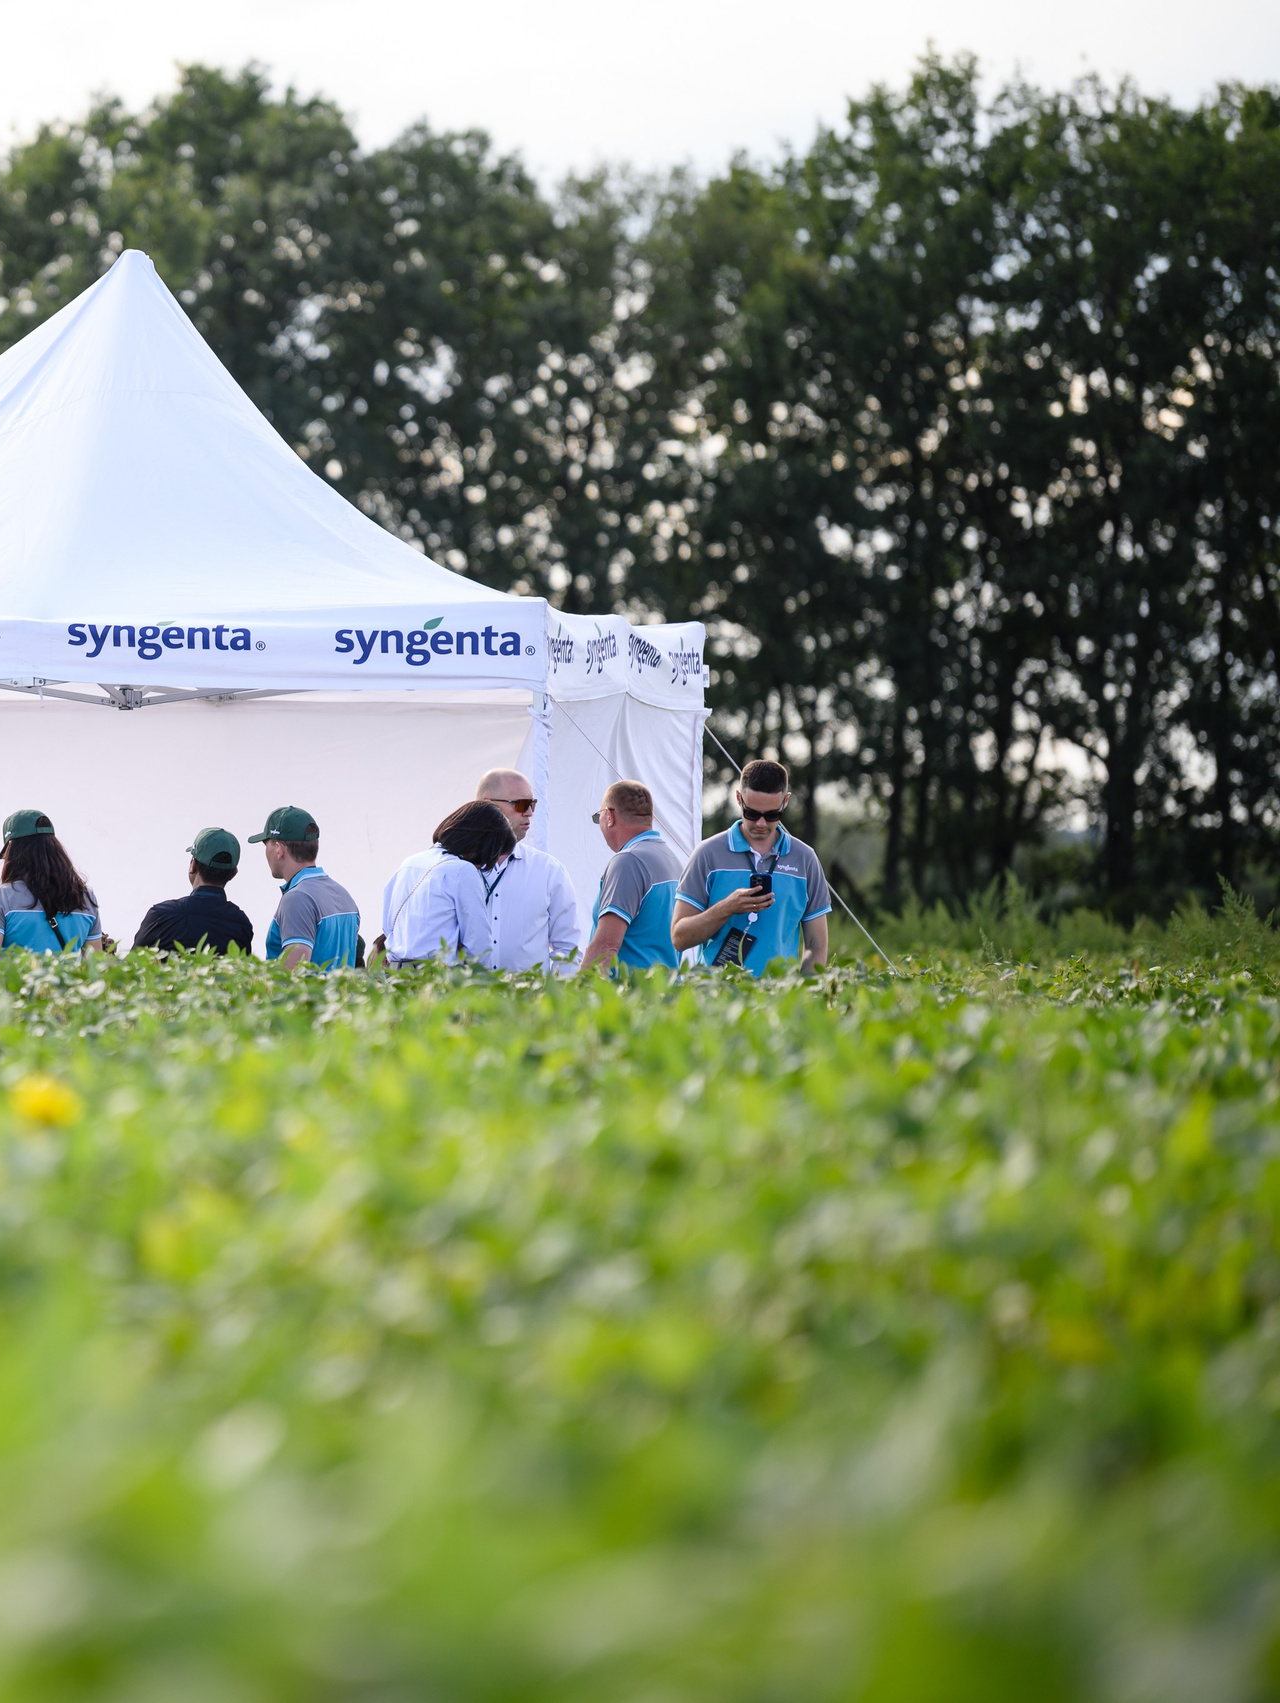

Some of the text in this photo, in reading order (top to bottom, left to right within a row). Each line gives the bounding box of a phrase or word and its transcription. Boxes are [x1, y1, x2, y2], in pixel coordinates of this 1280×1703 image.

[68, 624, 251, 660] syngenta
[335, 626, 520, 666] syngenta
[547, 634, 574, 674] yngenta
[586, 630, 616, 674] syngenta
